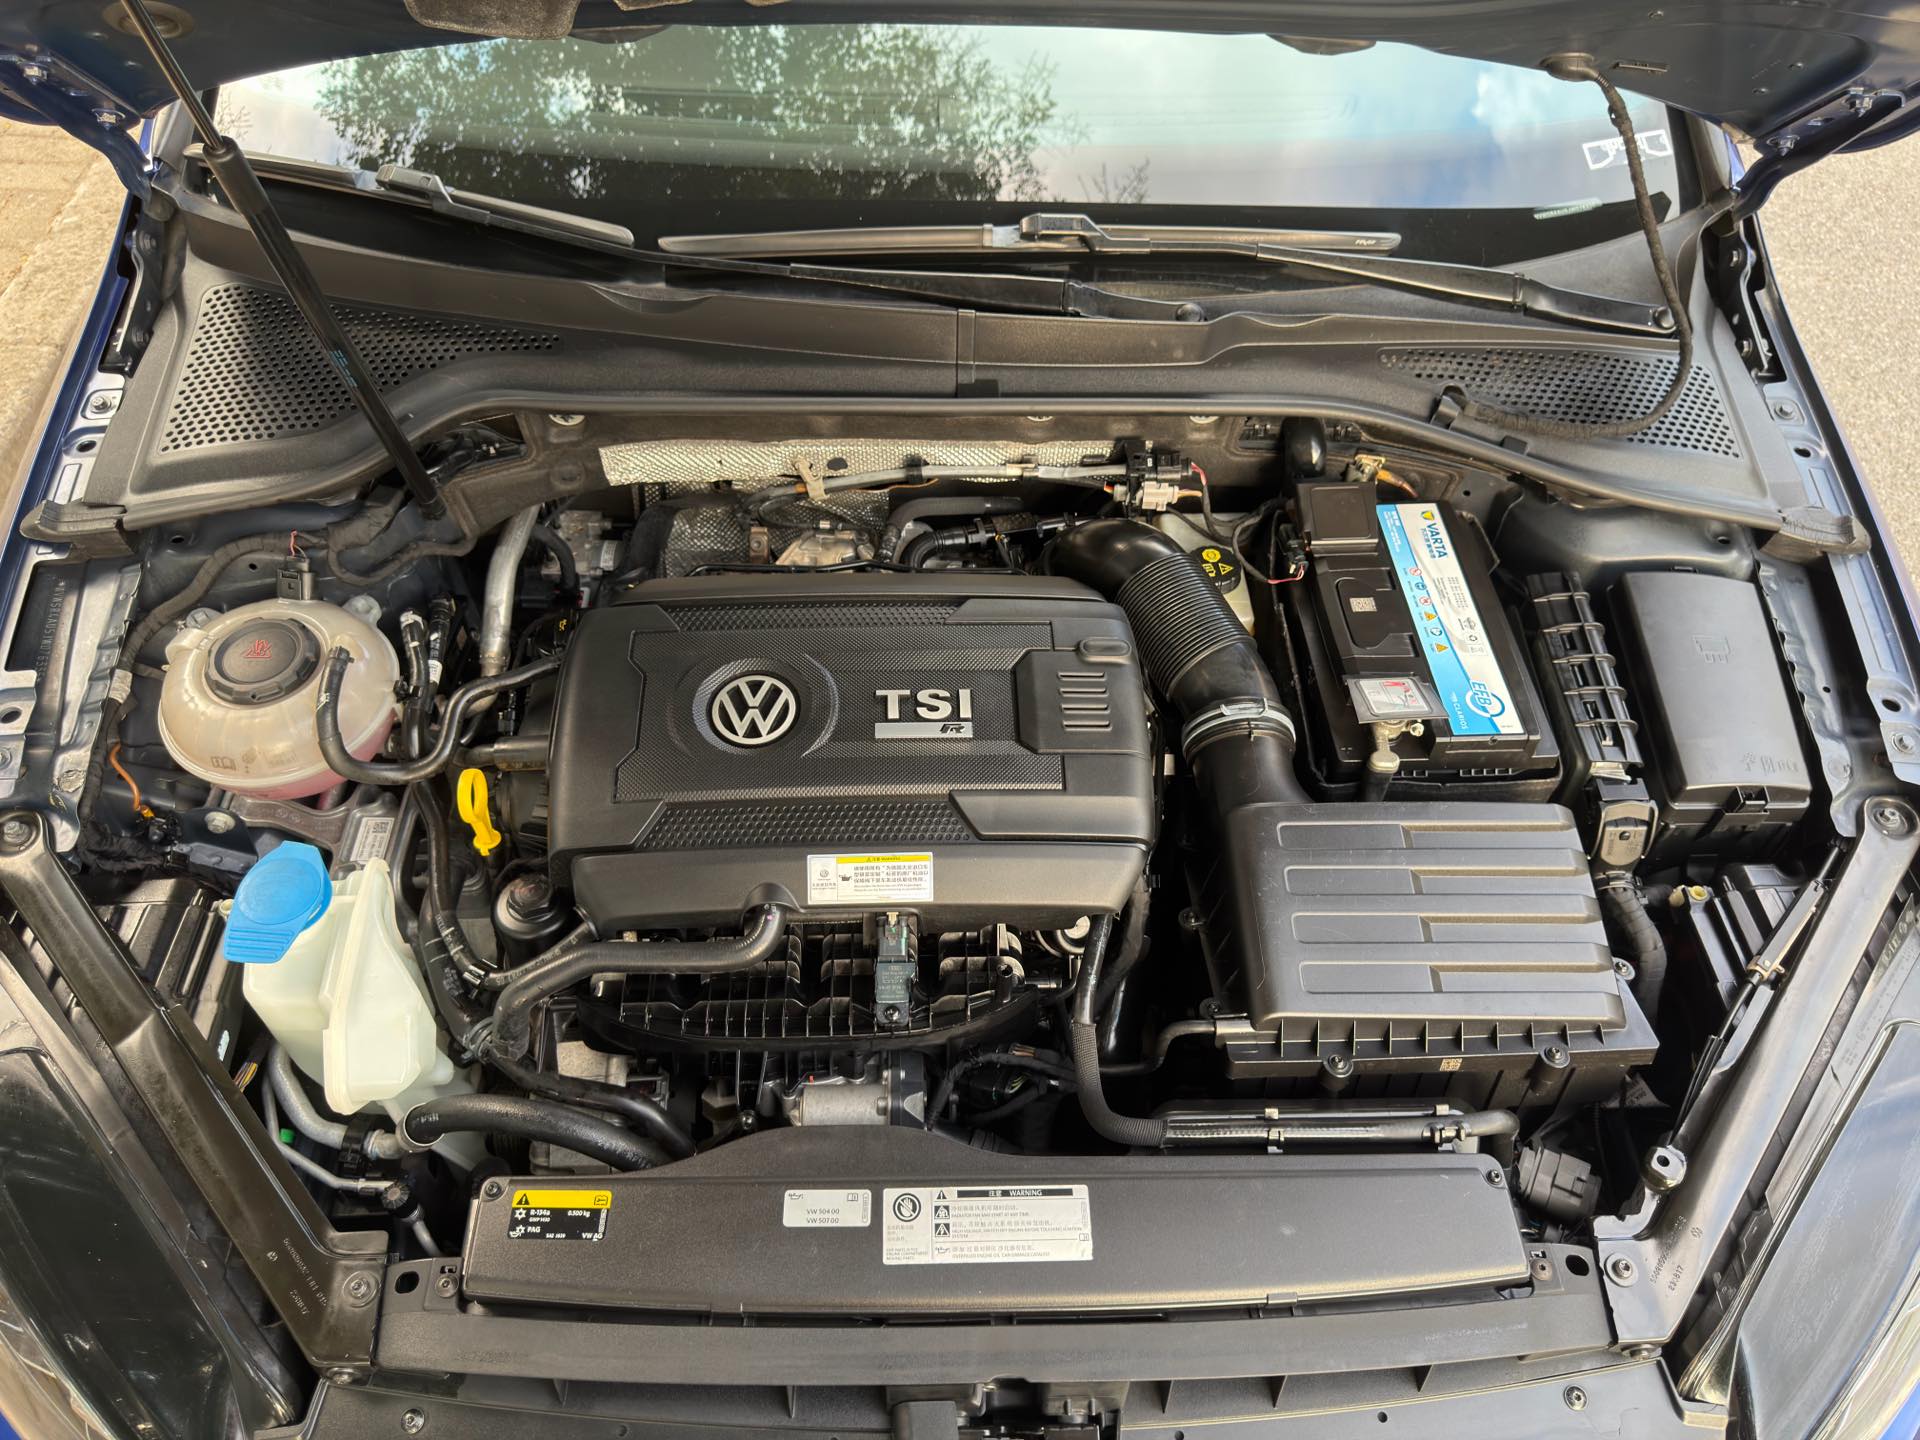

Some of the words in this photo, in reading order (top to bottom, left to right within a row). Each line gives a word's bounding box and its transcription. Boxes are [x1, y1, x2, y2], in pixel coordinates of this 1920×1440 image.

[1426, 523, 1448, 558] VARTA
[875, 689, 972, 719] TSI
[1472, 681, 1492, 706] EFB
[713, 675, 796, 745] VW
[1453, 702, 1469, 730] CLARIOS
[1009, 1189, 1043, 1197] WARNING
[529, 1209, 551, 1217] R-134a
[567, 1209, 583, 1217] 0.500
[583, 1209, 591, 1218] kg
